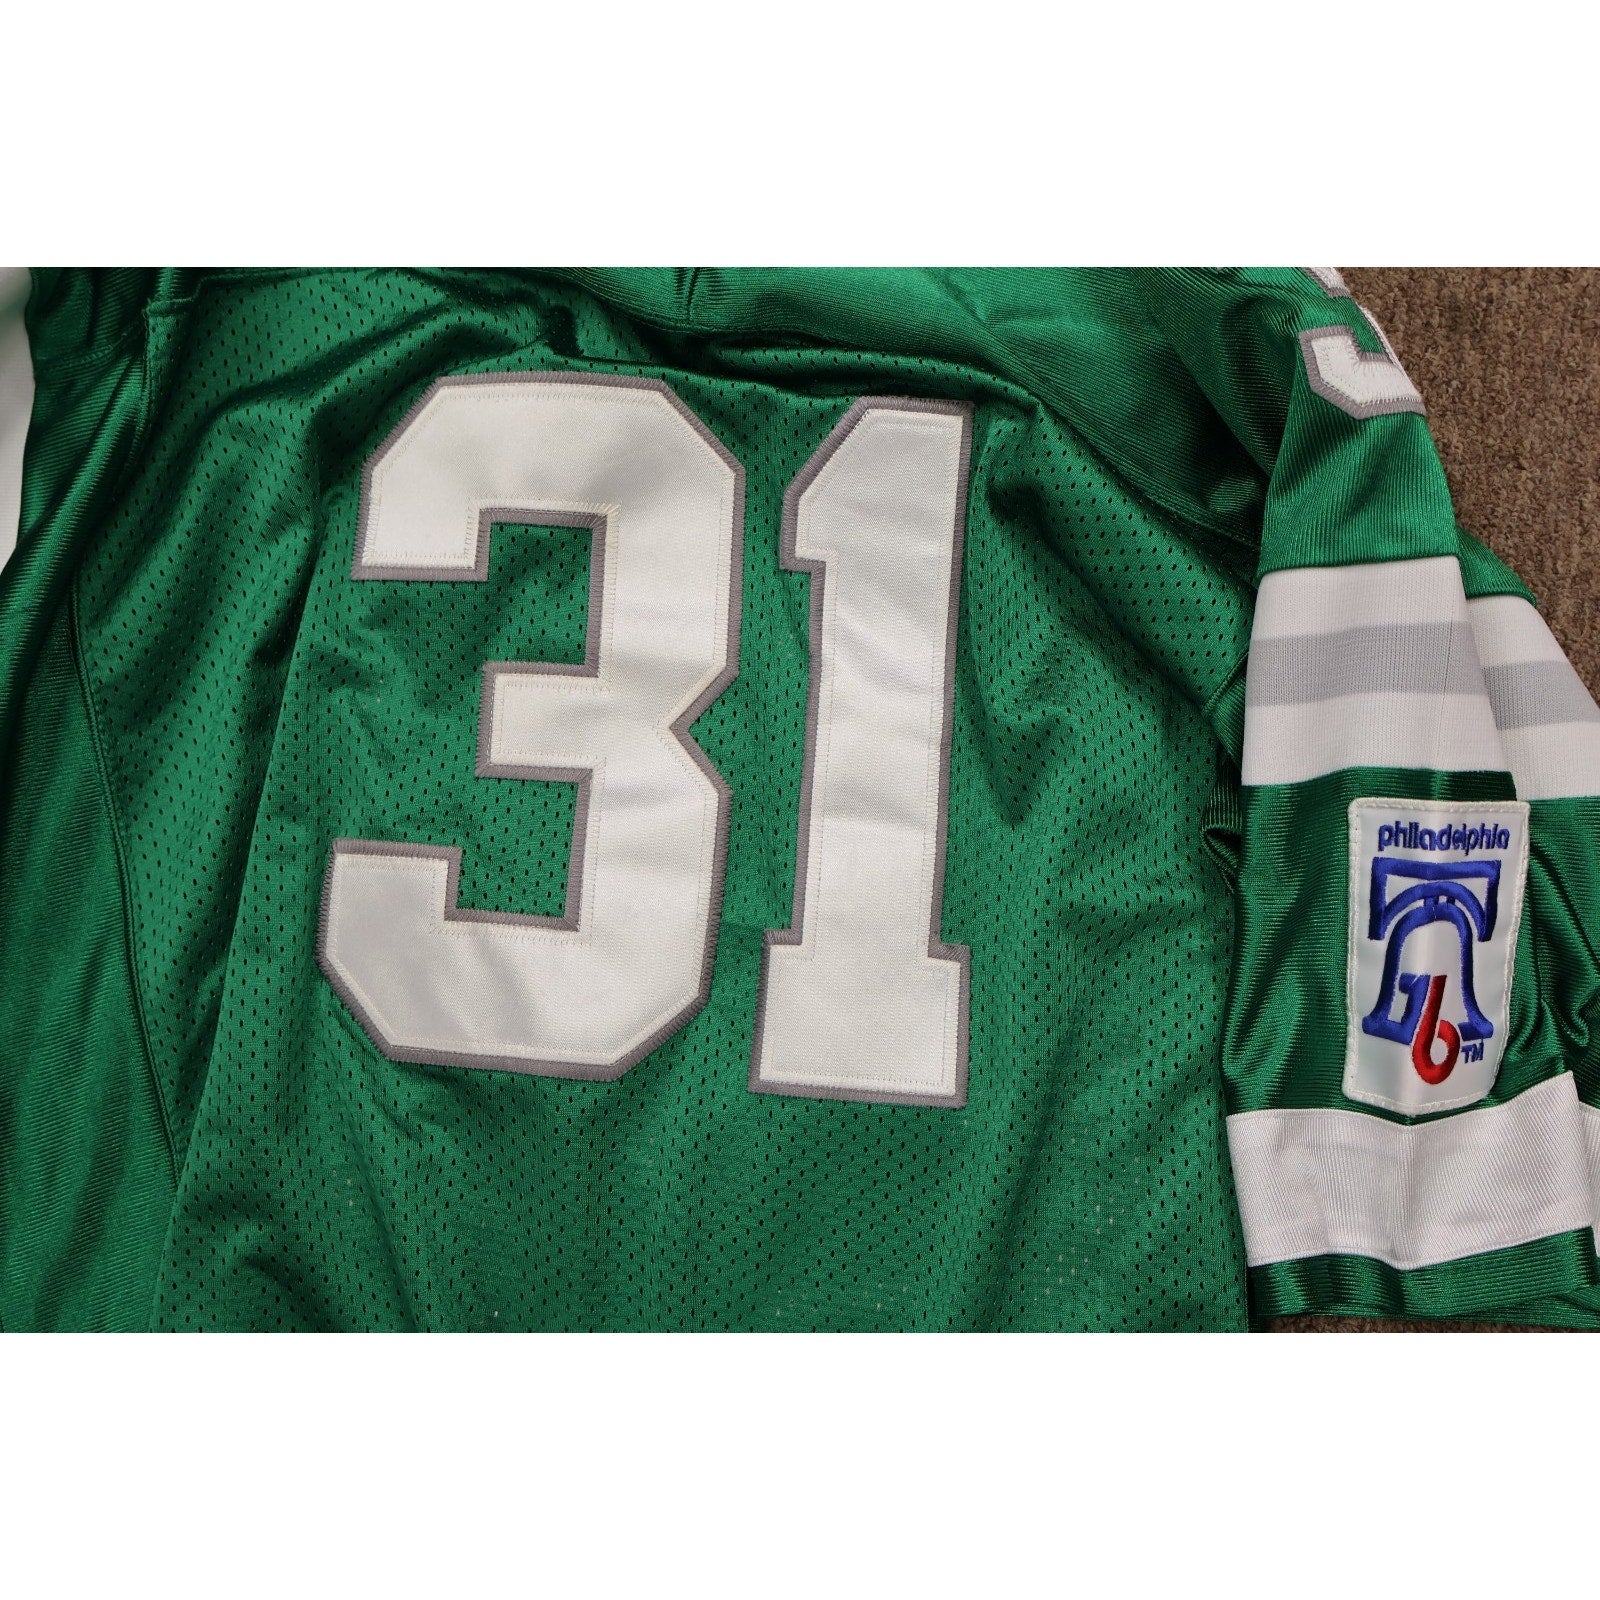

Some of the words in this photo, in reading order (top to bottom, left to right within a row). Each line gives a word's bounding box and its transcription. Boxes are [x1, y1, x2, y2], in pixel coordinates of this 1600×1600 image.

[317, 370, 975, 1108] 31
[1377, 820, 1511, 856] philadelphia
[1460, 1040, 1484, 1064] TM
